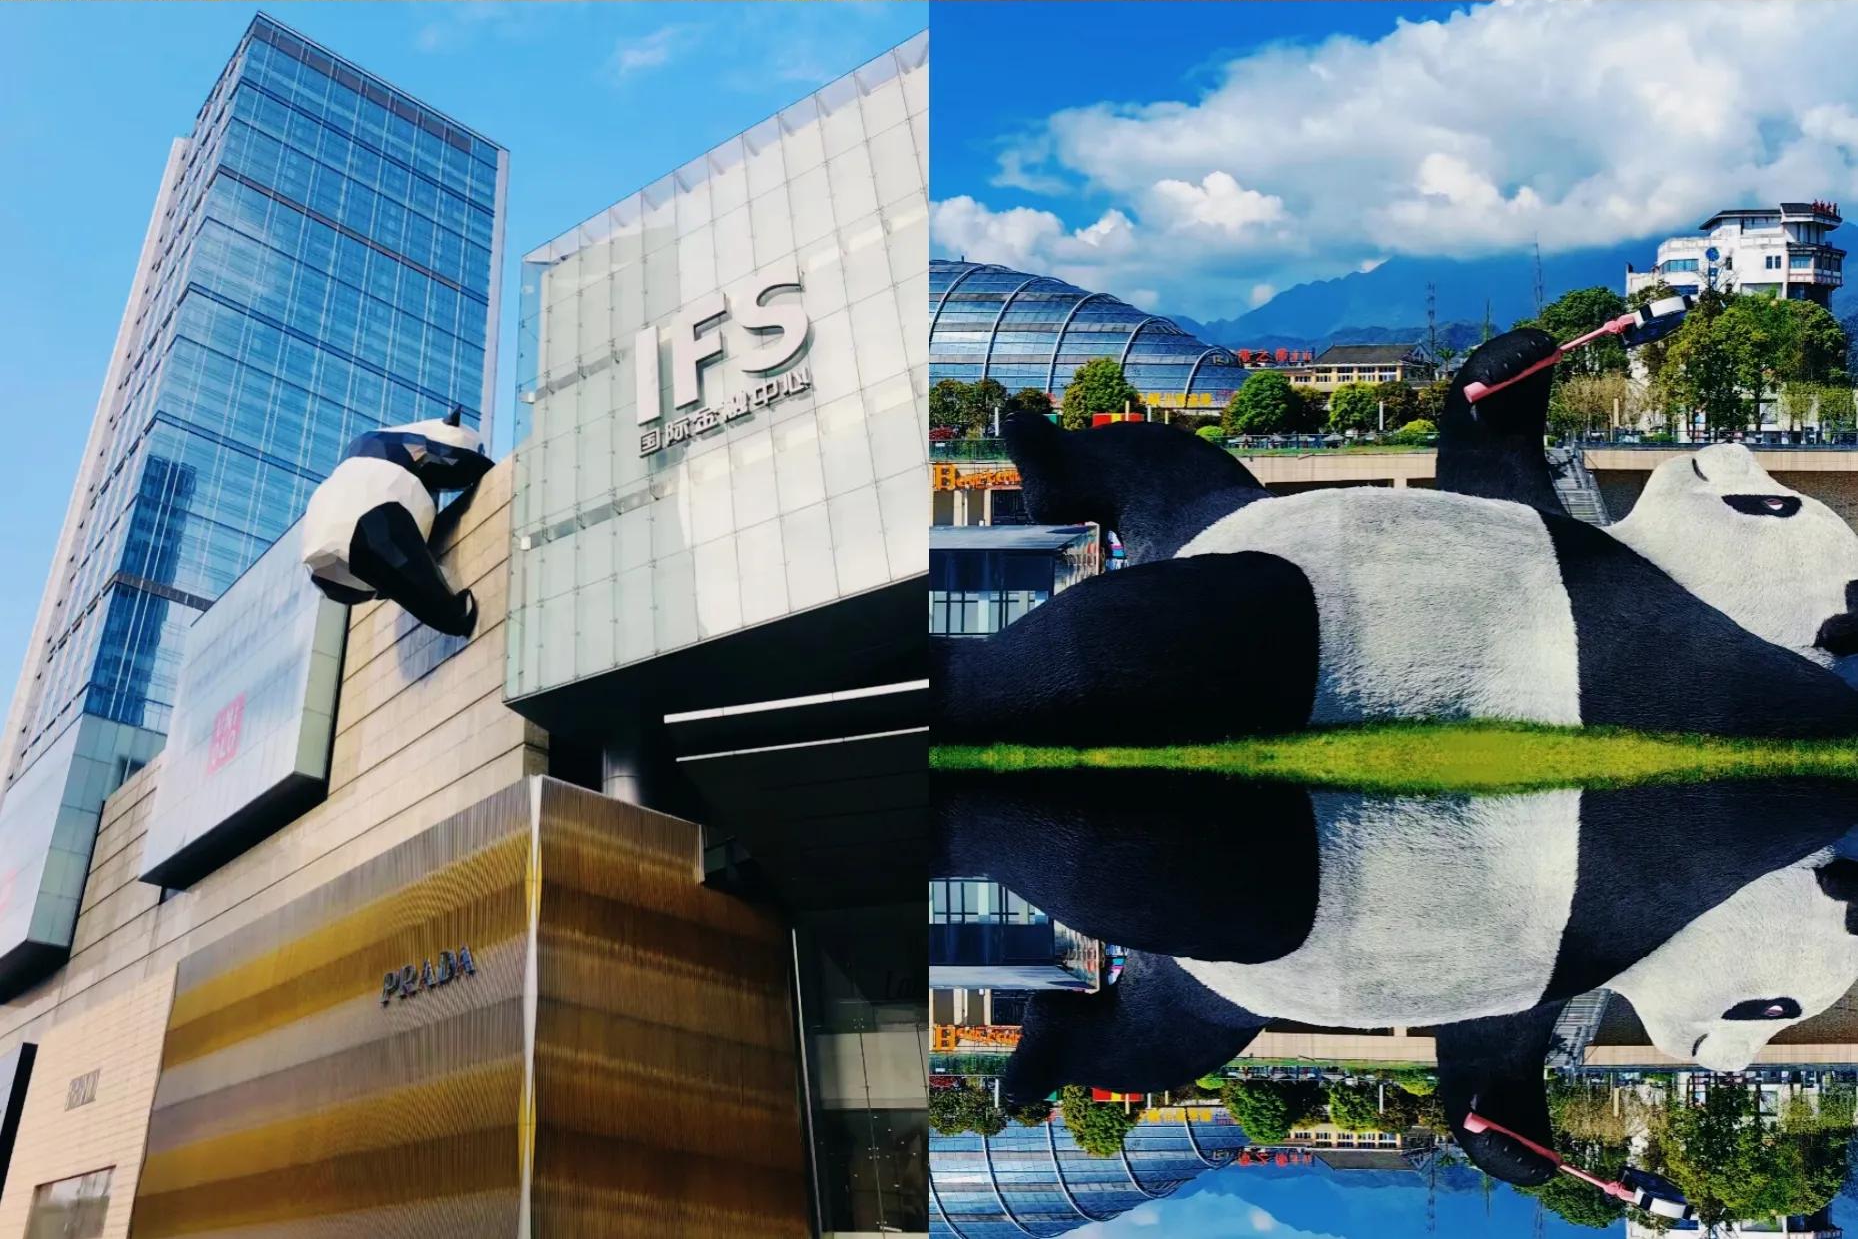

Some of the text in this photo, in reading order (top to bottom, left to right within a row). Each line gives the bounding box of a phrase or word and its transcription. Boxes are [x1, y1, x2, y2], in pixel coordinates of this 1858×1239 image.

[636, 268, 814, 426] IFS
[639, 367, 812, 459] 国际金融中心
[381, 944, 477, 1007] PRADA
